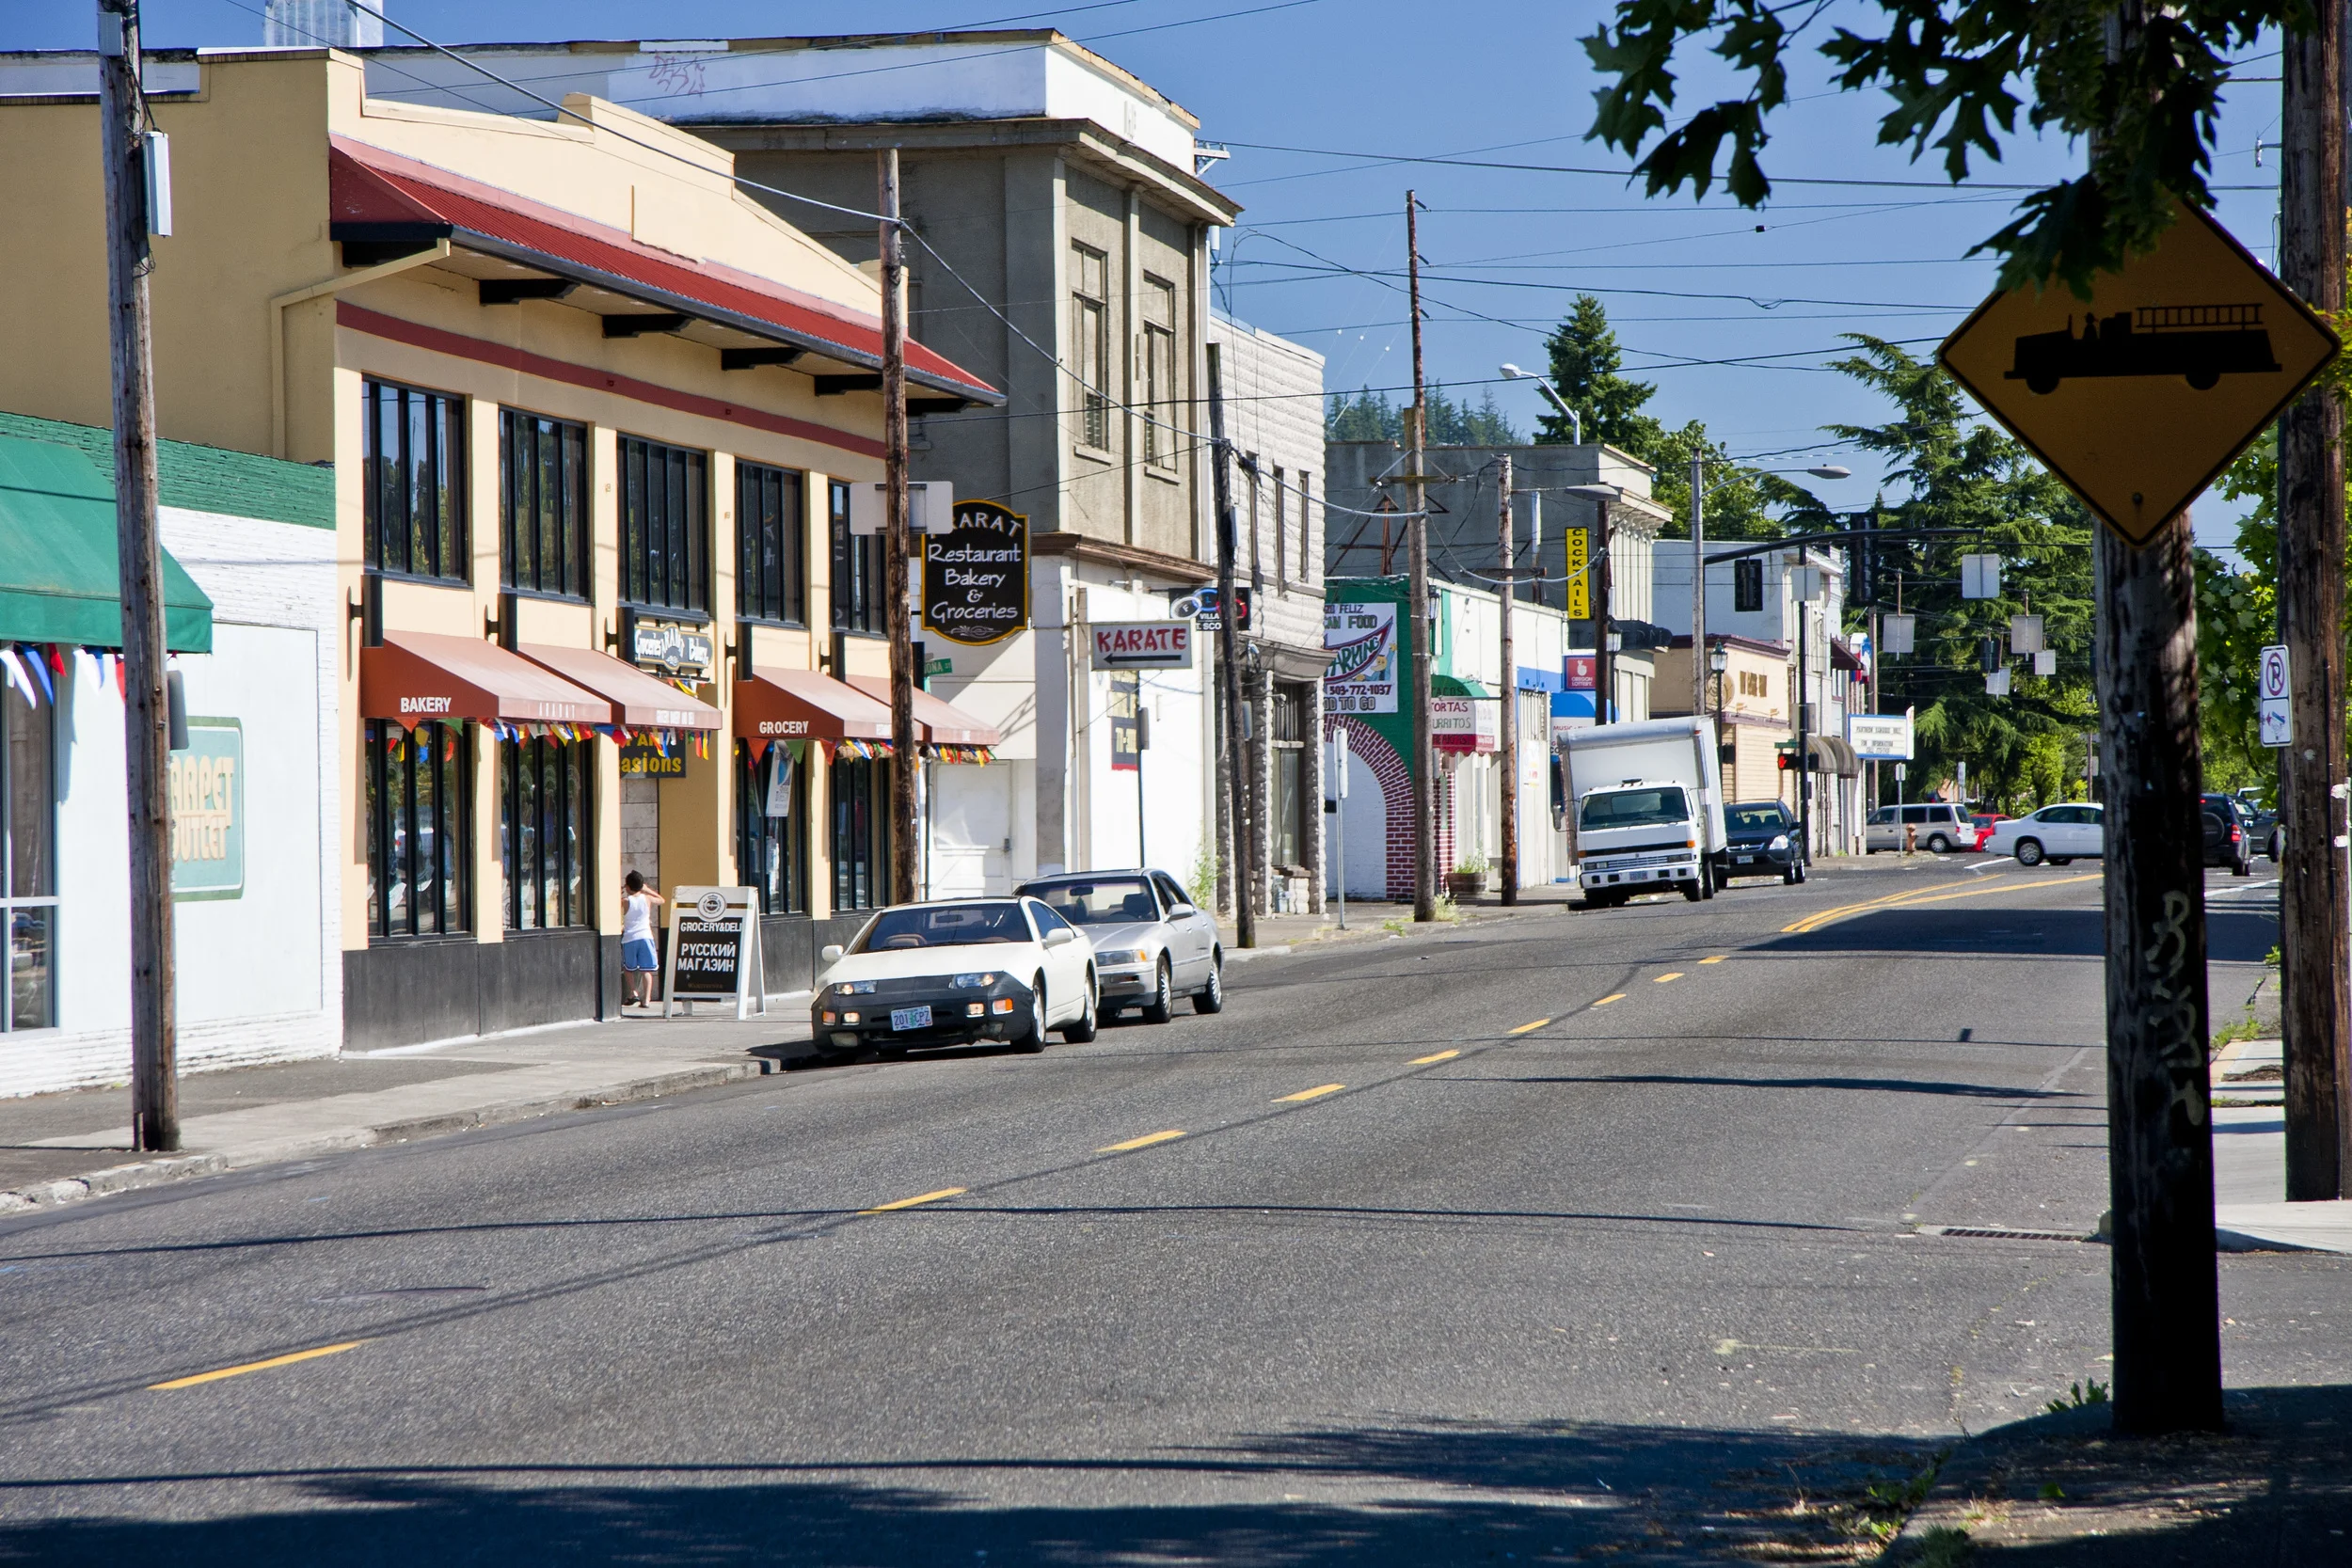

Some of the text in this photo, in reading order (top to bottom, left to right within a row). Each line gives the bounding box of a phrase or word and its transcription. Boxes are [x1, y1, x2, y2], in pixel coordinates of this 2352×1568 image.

[930, 513, 1023, 538] ARAT
[928, 543, 1022, 562] Restaurant
[945, 568, 1006, 588] Bakery
[1572, 529, 1582, 616] COCKTAILS
[966, 589, 983, 603] &
[930, 602, 1018, 623] Groceries
[1339, 604, 1364, 613] FELIZ
[1202, 622, 1222, 630] SCO
[1347, 614, 1377, 629] FOOD
[1096, 627, 1187, 653] KARATE
[1324, 636, 1379, 677] ARKING
[401, 697, 452, 713] BAKERY
[1324, 697, 1376, 711] OD TO GO
[759, 721, 809, 735] GROCERY
[1433, 718, 1471, 729] URRITOS
[621, 752, 682, 773] asions
[170, 754, 234, 826] ARPET
[680, 922, 742, 932] GROCERY&DELI
[680, 942, 736, 958] РУССКИЙ
[677, 958, 735, 973] МАГАЗИН
